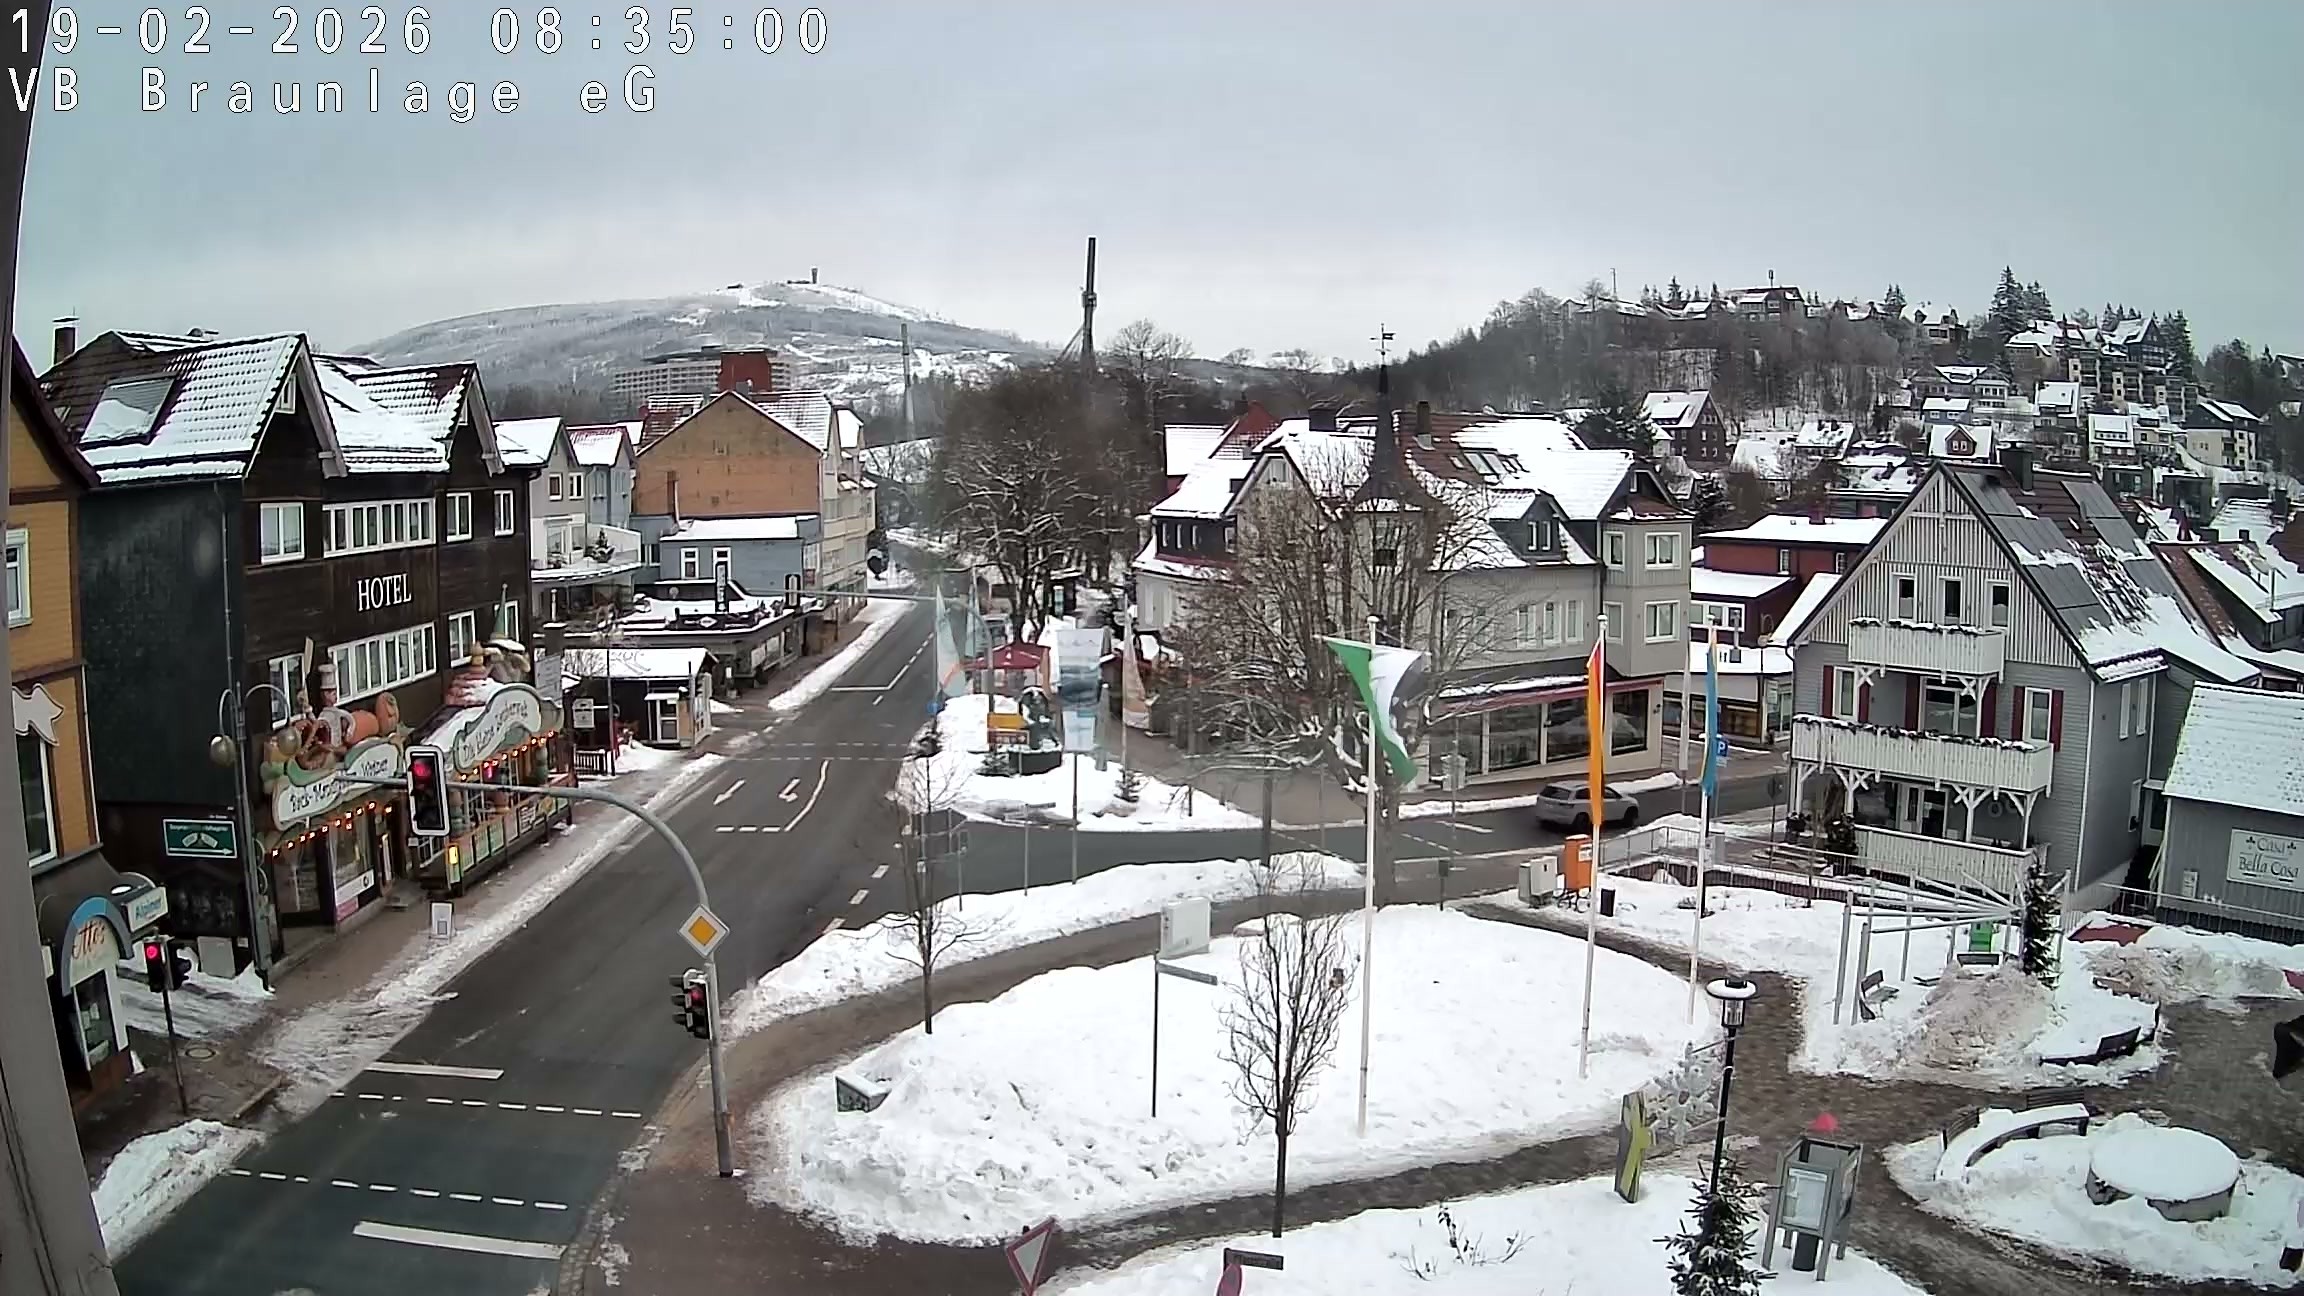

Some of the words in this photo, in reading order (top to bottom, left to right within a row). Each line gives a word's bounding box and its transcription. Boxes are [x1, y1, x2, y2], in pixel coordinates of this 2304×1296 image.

[357, 573, 412, 612] HOTEL
[1717, 741, 1726, 754] P
[2239, 853, 2268, 873] Bella
